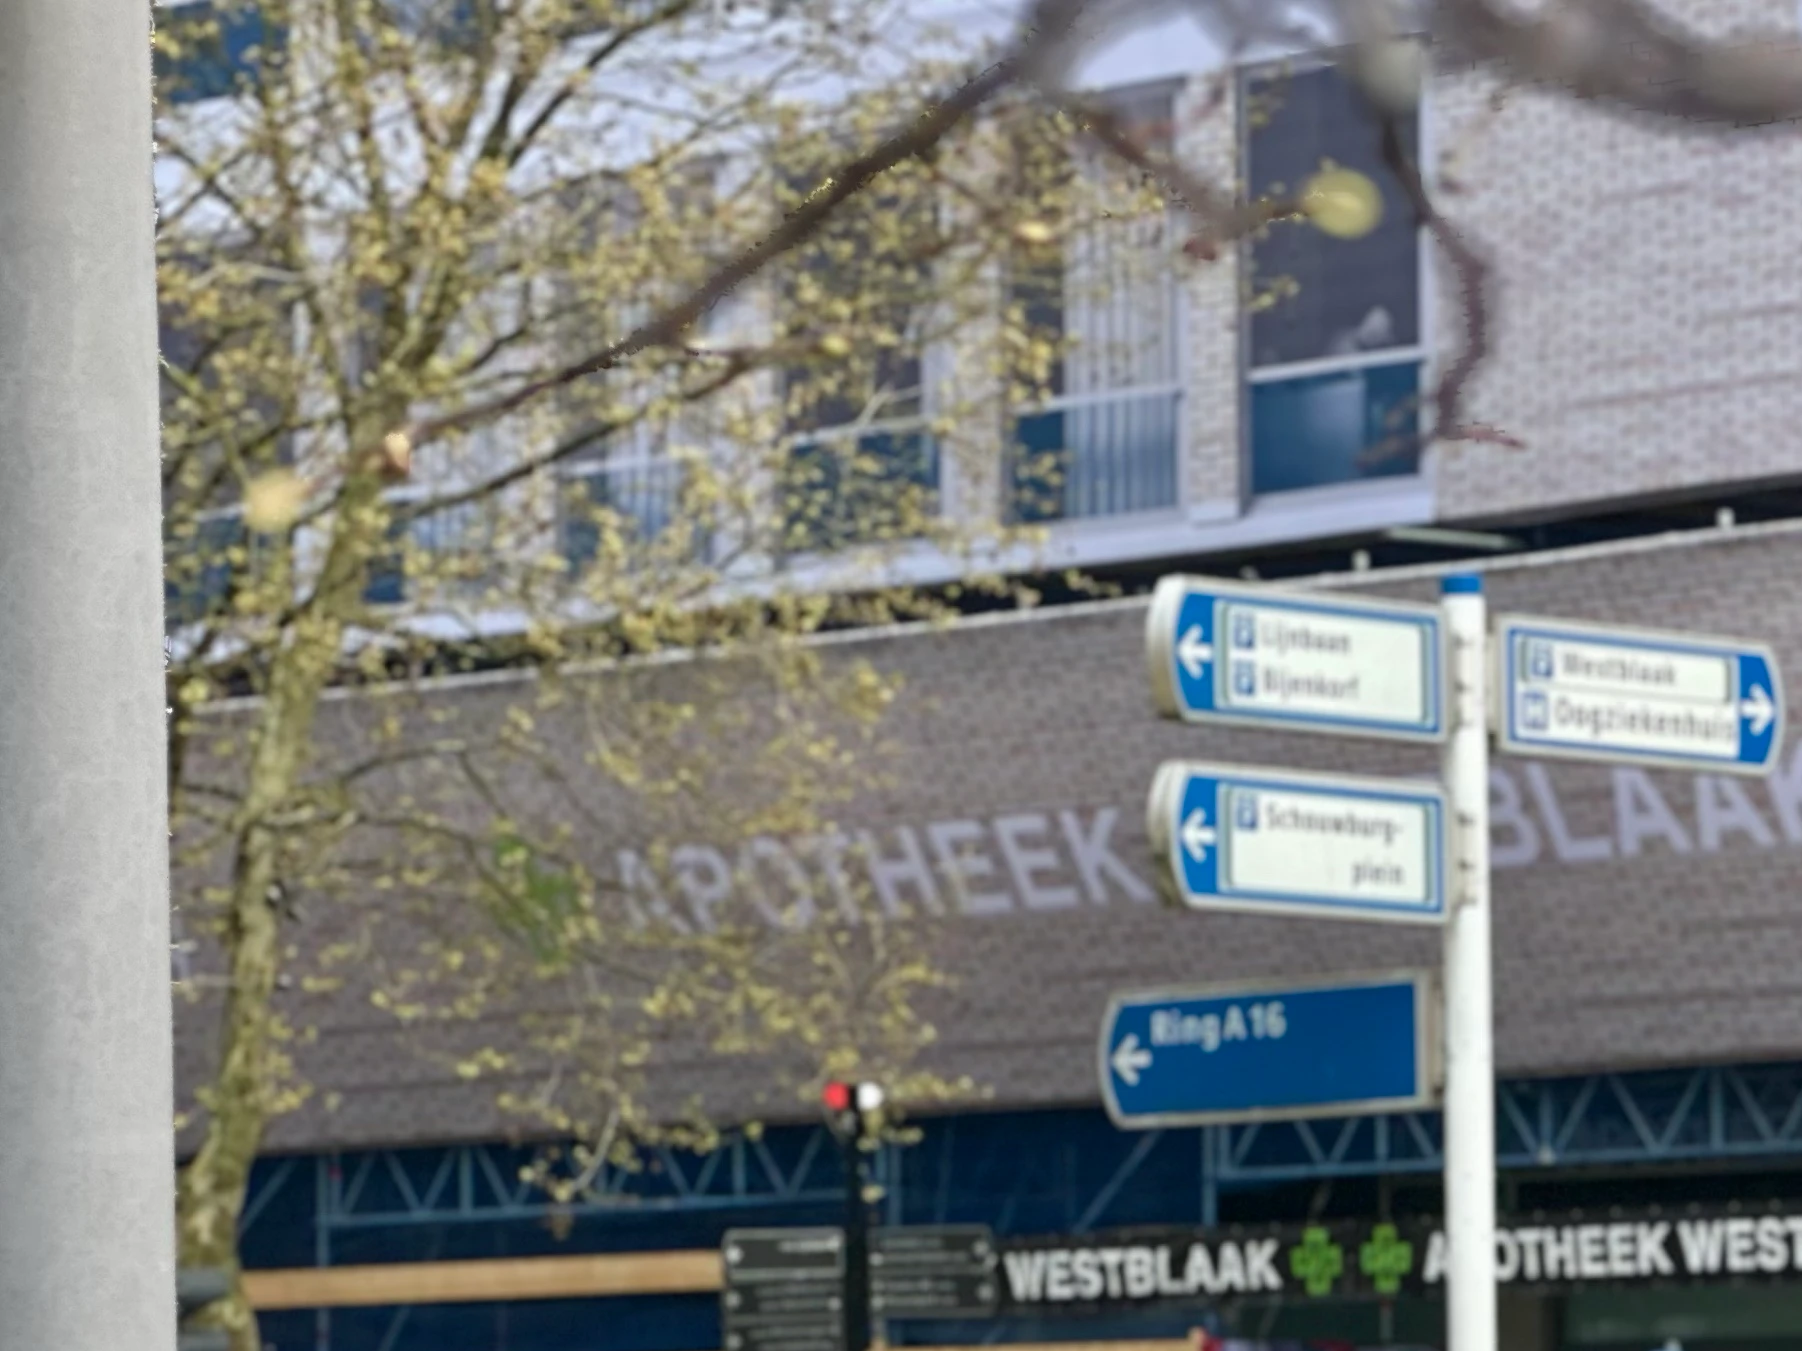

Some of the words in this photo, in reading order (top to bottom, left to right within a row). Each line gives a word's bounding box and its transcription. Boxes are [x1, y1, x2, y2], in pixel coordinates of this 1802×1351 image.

[1261, 618, 1352, 657] Lijnbaan
[1262, 666, 1360, 702] Bijenkorf
[1562, 651, 1676, 685] Westblaak
[616, 806, 1157, 936] APOTHEEK
[1351, 854, 1405, 889] plein
[1150, 1007, 1221, 1053] Ring
[1003, 1237, 1282, 1302] WESTBLAAK
[1422, 1221, 1672, 1284] AOTHEEK
